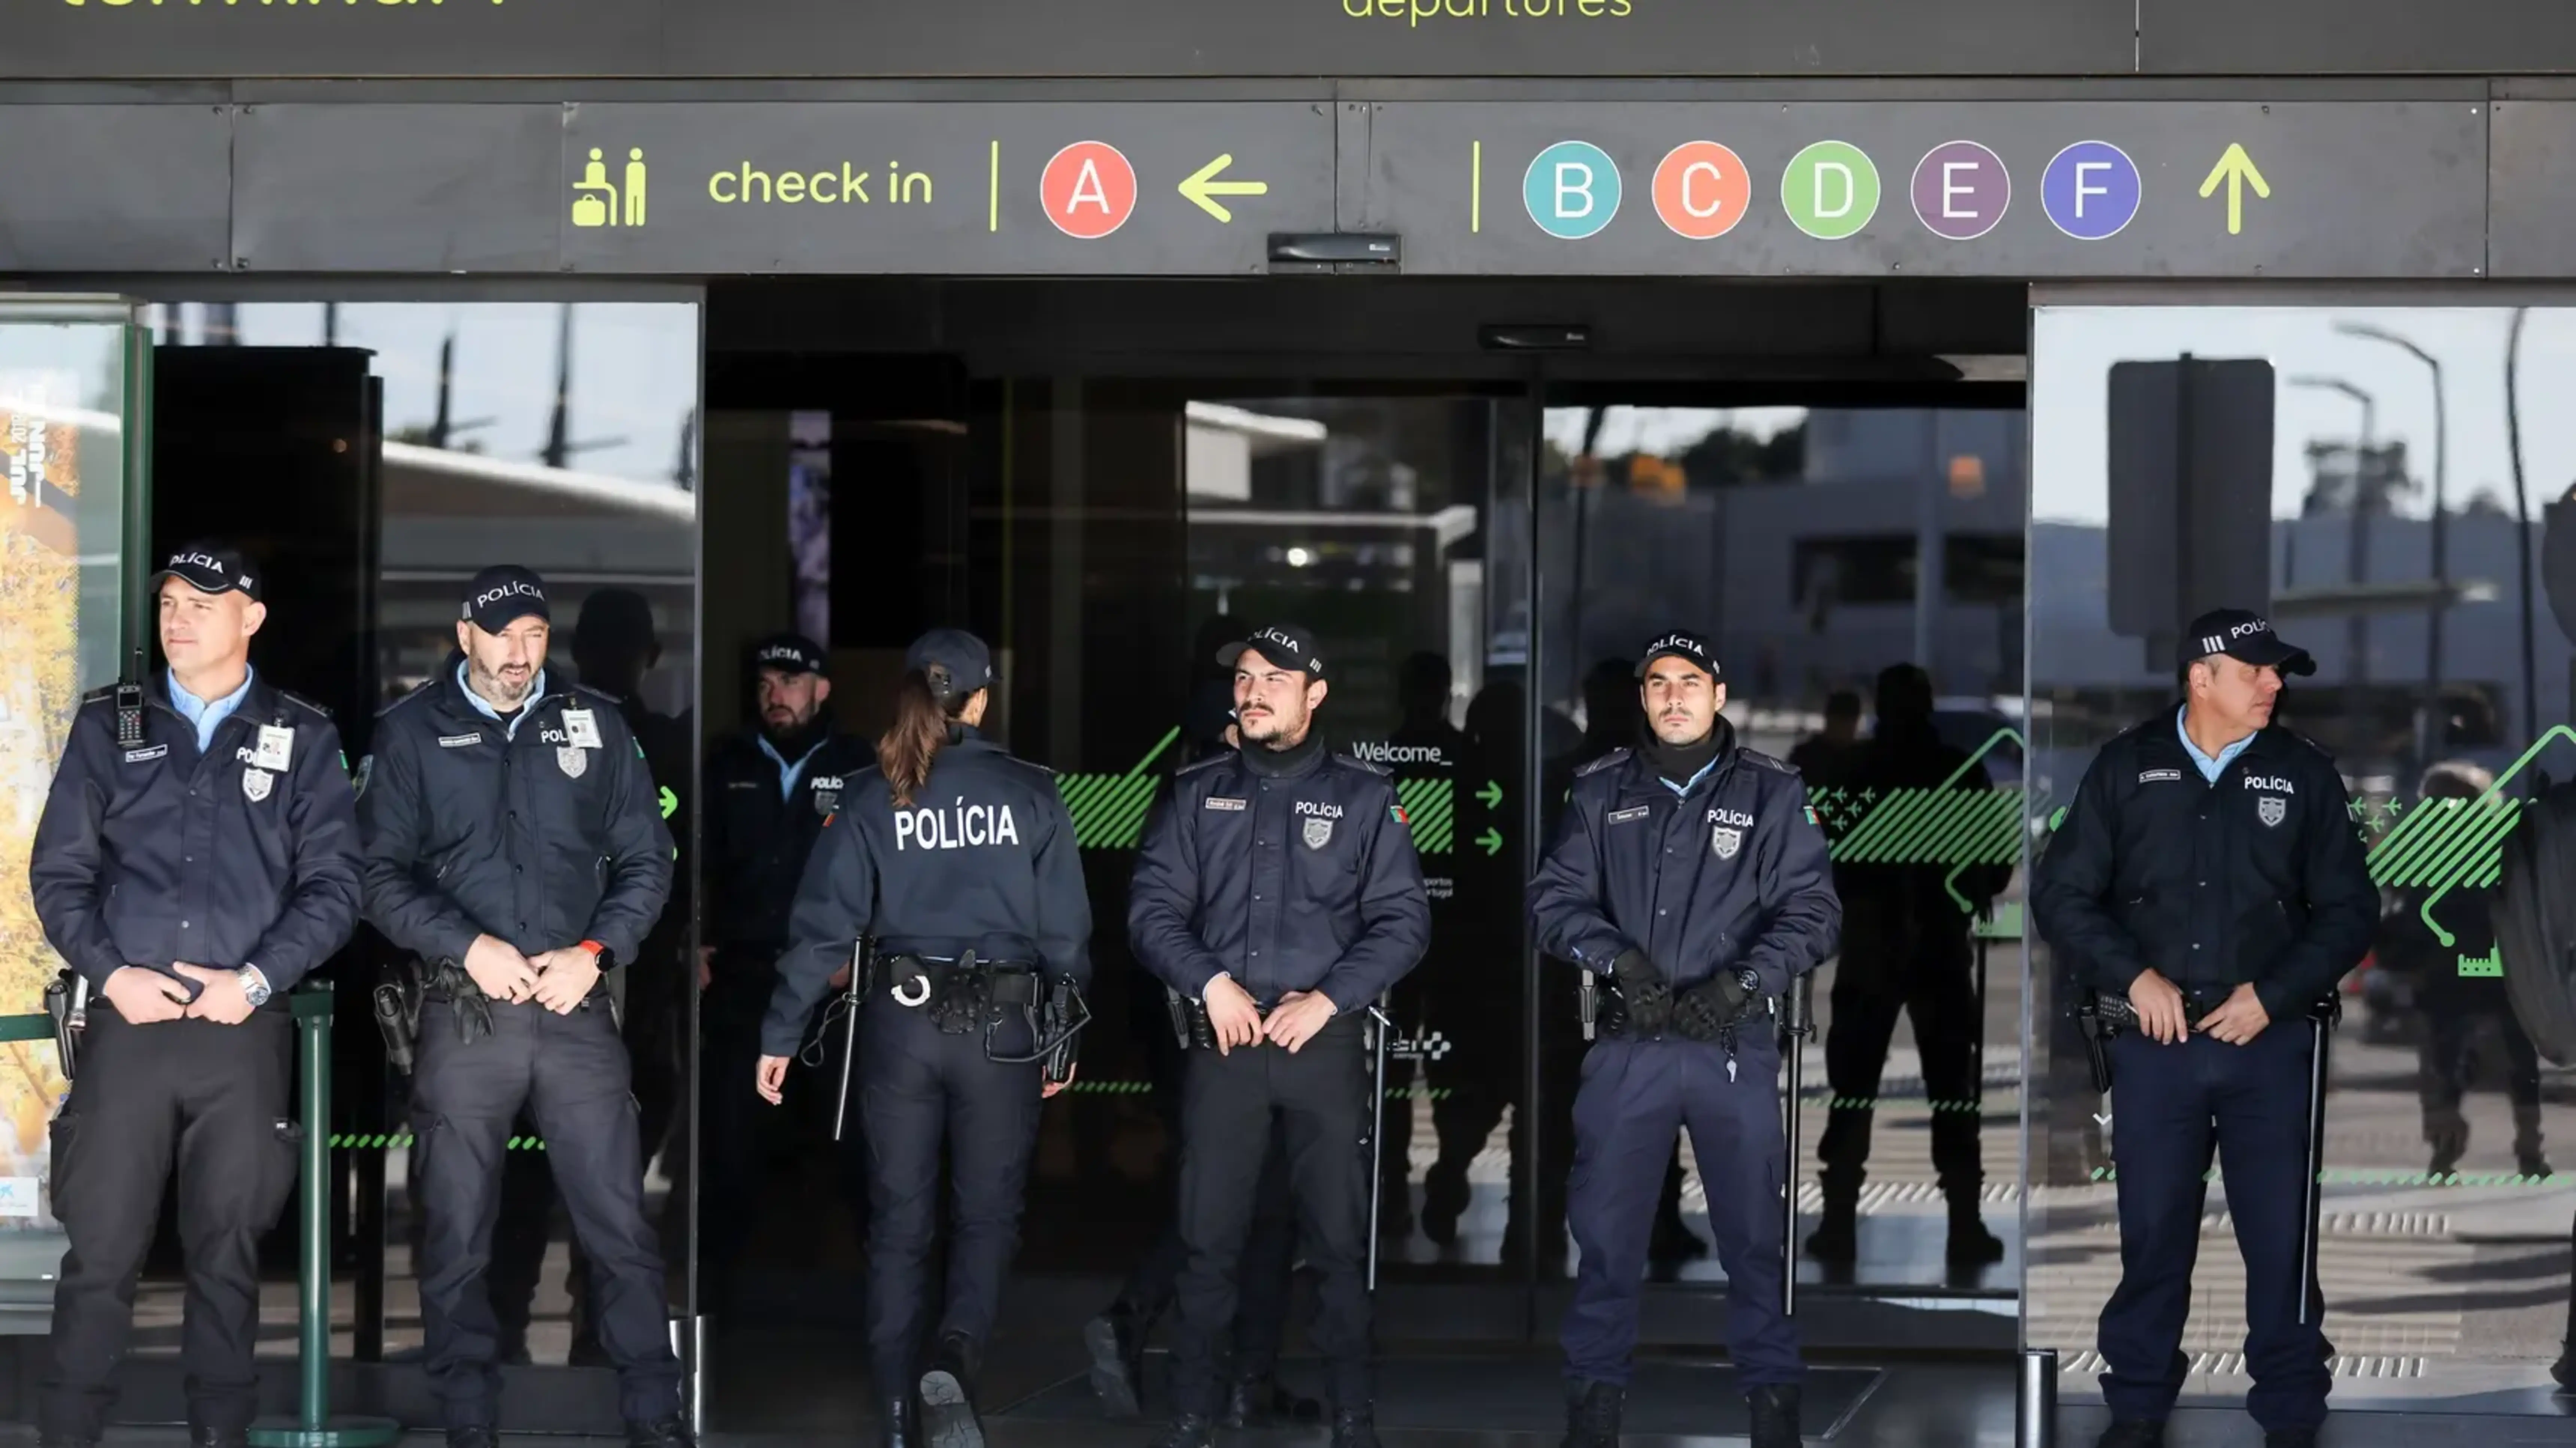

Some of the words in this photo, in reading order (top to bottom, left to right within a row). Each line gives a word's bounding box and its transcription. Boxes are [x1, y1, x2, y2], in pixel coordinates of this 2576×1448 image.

[709, 162, 869, 202] check
[890, 162, 931, 202] in
[1067, 159, 1109, 213] A
[1556, 163, 1593, 217] B
[1683, 162, 1720, 217] C
[1814, 162, 1853, 217] D
[1944, 163, 1978, 217] E
[2076, 163, 2111, 217] F
[10, 448, 27, 505] JUL
[477, 581, 545, 608] POLÍCIA
[2244, 773, 2294, 794] POLÍCIA
[895, 796, 1019, 851] POLÍCIA
[1295, 801, 1343, 818] POLÍCIA
[1708, 809, 1753, 827] POLÍCIA
